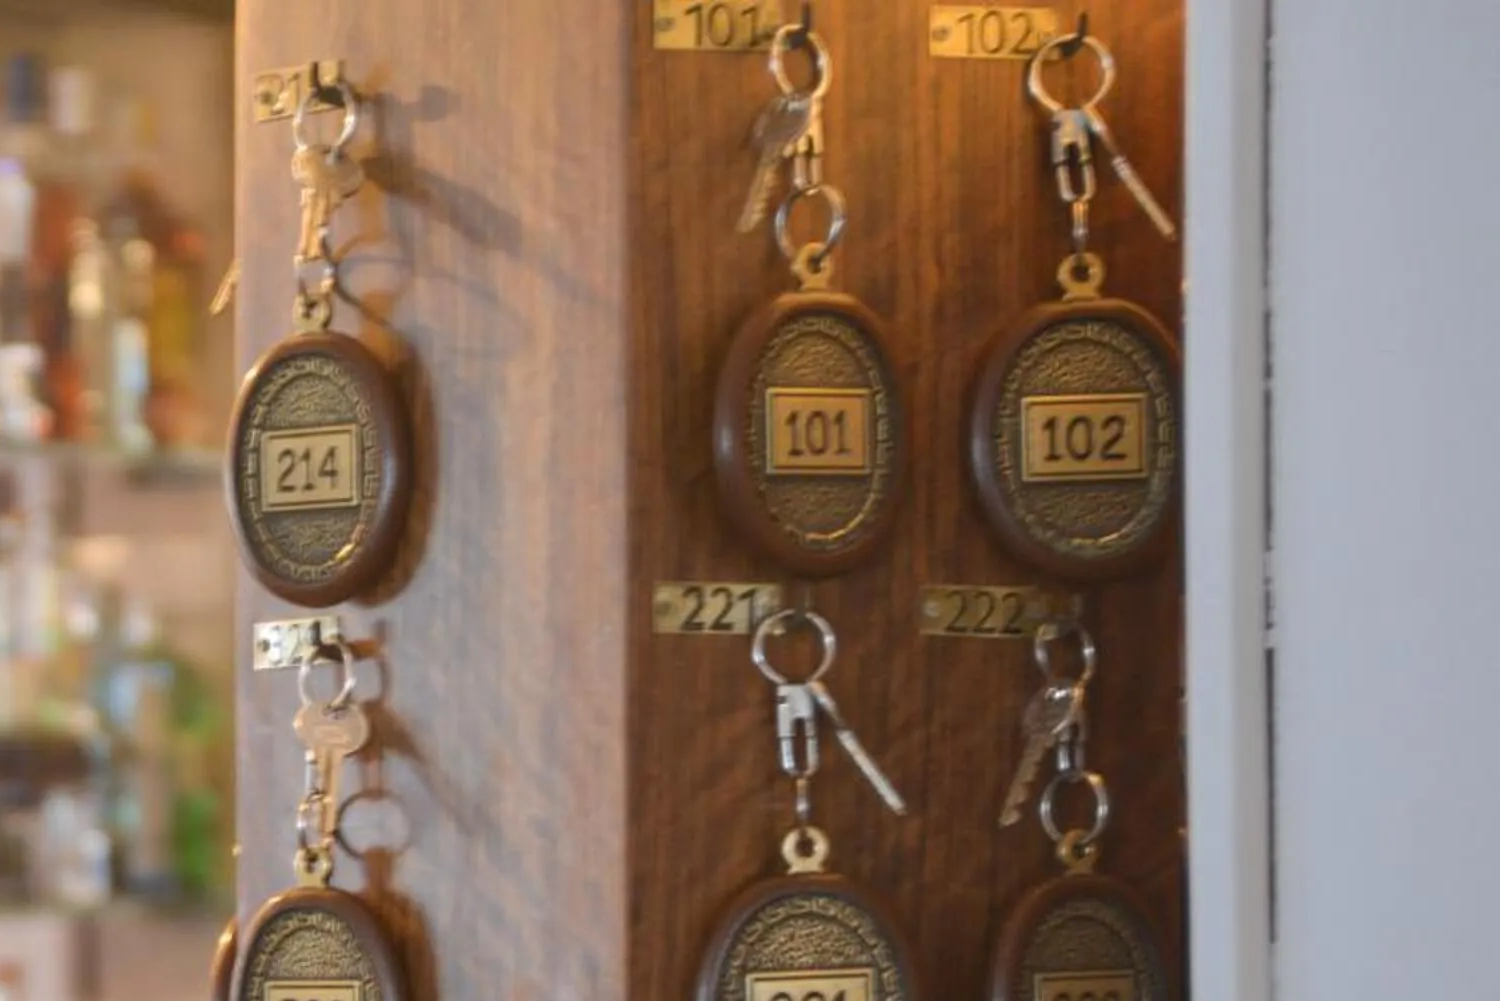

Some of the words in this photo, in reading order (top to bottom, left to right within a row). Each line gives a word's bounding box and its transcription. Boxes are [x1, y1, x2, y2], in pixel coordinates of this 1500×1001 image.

[684, 4, 758, 48] 101
[957, 10, 1039, 55] 102
[785, 410, 852, 457] 101
[1042, 415, 1128, 461] 102
[277, 446, 339, 493] 214
[681, 585, 758, 632] 221
[944, 590, 1023, 634] 222
